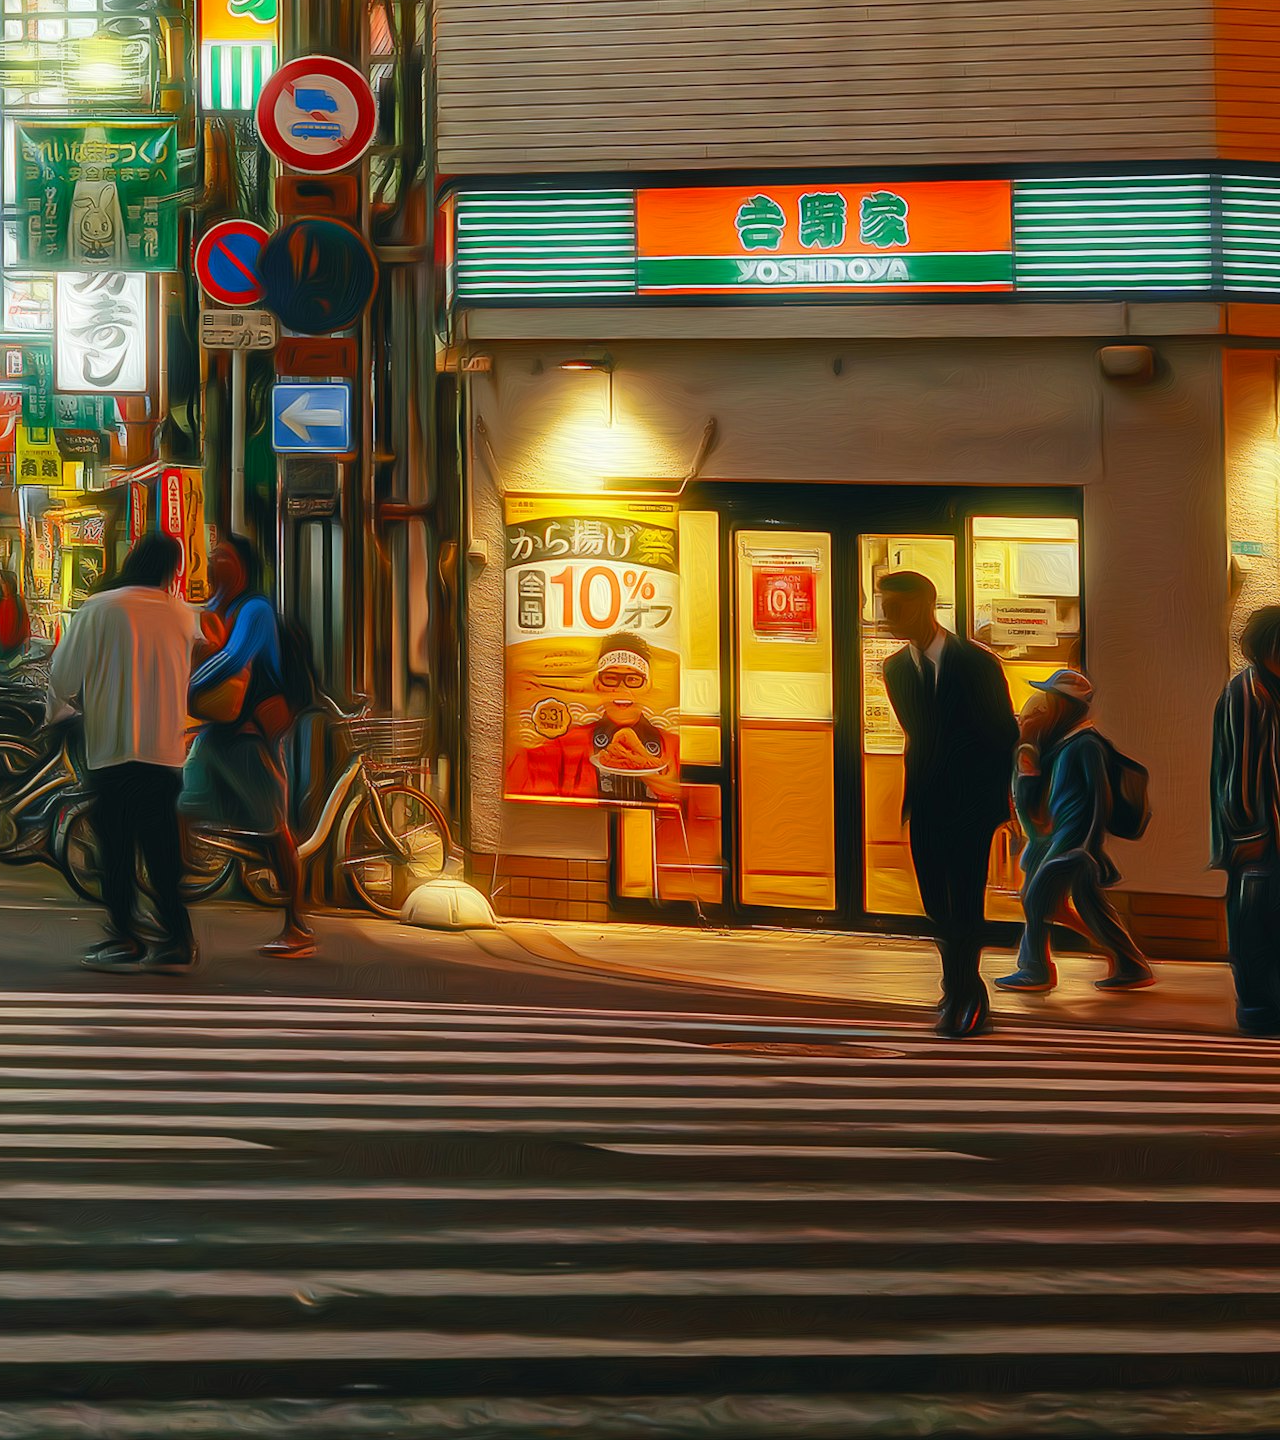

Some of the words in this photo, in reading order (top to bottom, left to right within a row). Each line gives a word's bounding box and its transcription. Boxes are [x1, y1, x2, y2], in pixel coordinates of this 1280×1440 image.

[21, 139, 169, 164] きれいなまちづくり
[734, 189, 911, 251] 吉野家
[736, 256, 911, 286] YOSHINOYA
[202, 329, 272, 347] ここから
[508, 517, 676, 566] から揚げ祭
[519, 570, 545, 627] 全品
[550, 564, 657, 630] 10%
[624, 603, 674, 630] オフ
